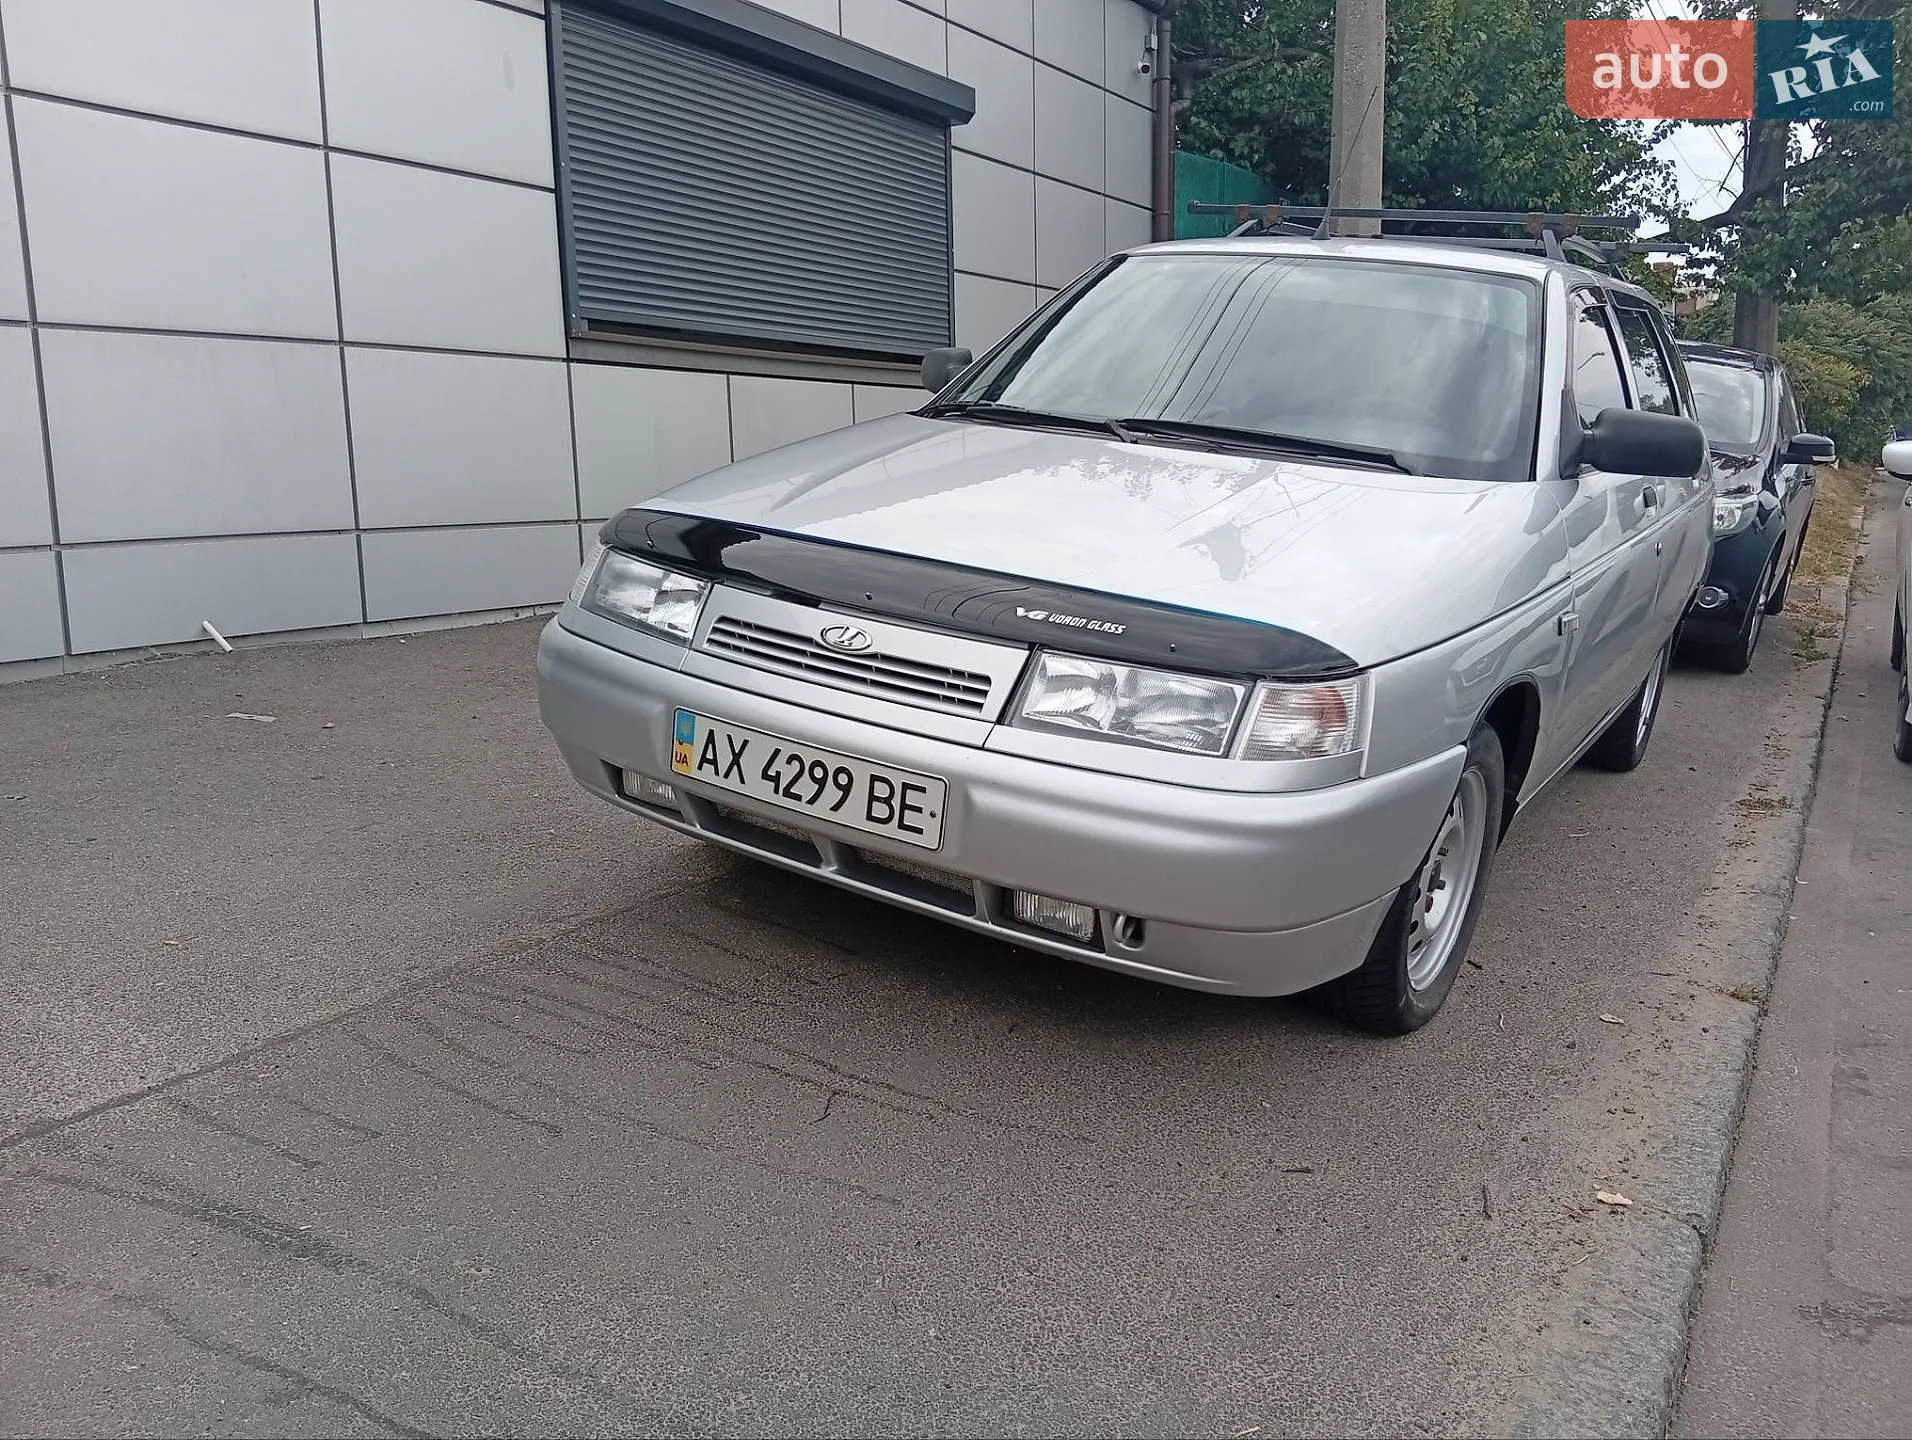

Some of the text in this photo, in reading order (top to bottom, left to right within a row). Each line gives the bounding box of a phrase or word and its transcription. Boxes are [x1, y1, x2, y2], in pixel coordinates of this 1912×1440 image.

[1086, 619, 1127, 634] GLASS
[674, 751, 689, 767] UA
[697, 728, 927, 835] AX 4299 BE
